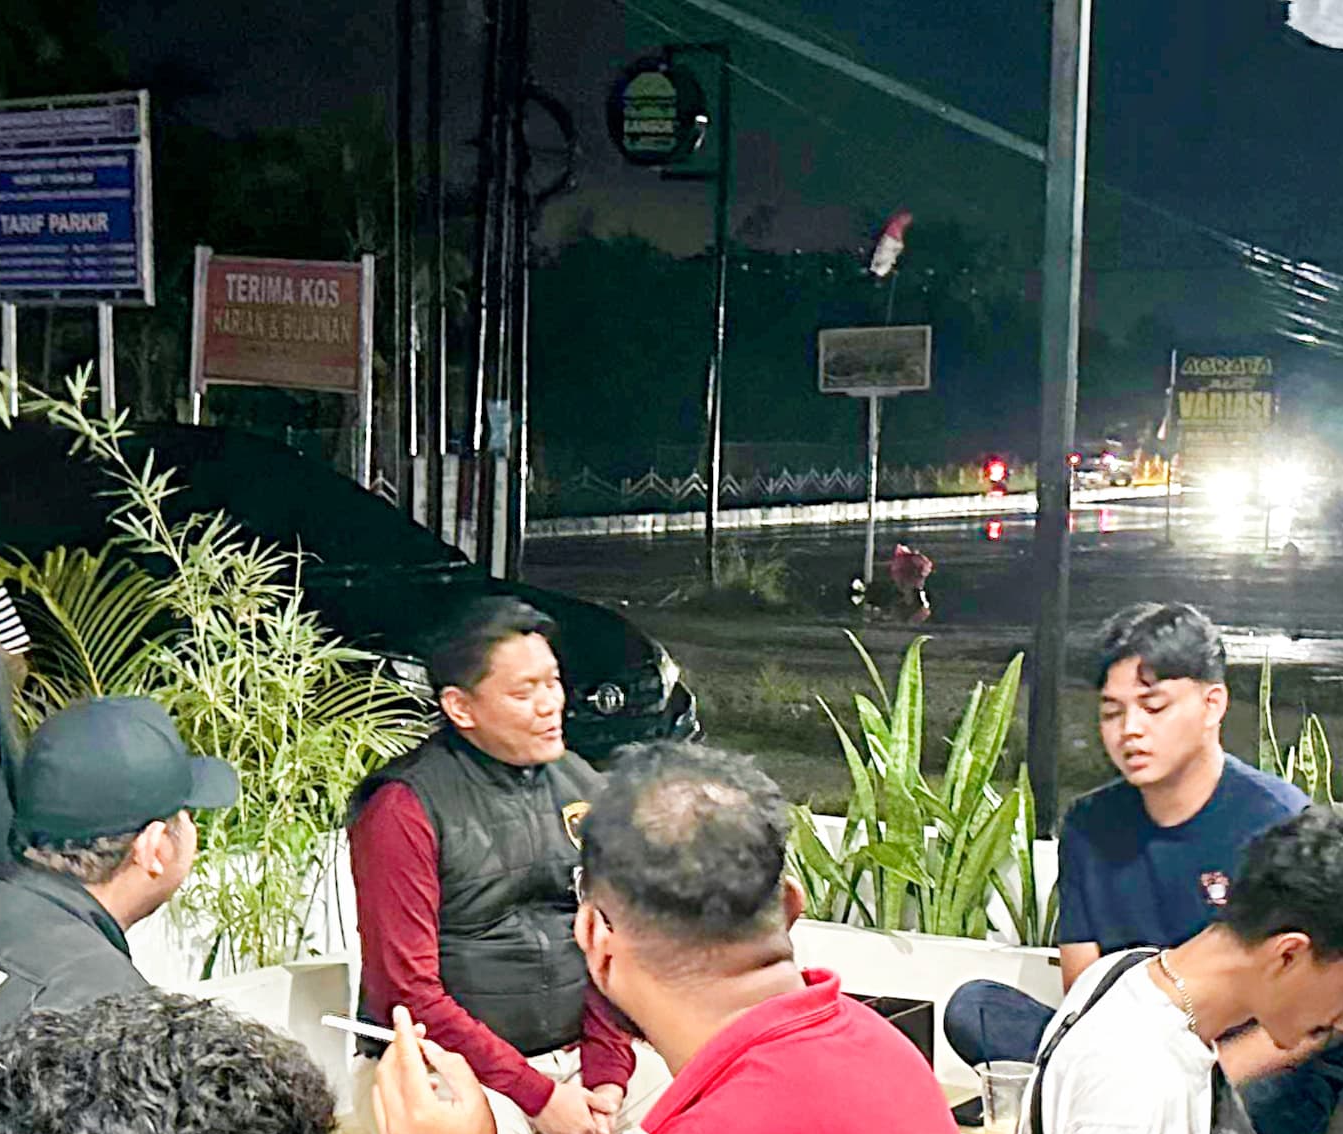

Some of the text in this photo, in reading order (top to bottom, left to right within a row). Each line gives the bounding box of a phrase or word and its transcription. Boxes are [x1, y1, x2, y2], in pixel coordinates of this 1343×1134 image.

[0, 212, 109, 235] TARIF PARKIR
[225, 273, 340, 308] TERIMA KOS
[1178, 392, 1272, 418] VARIASI
